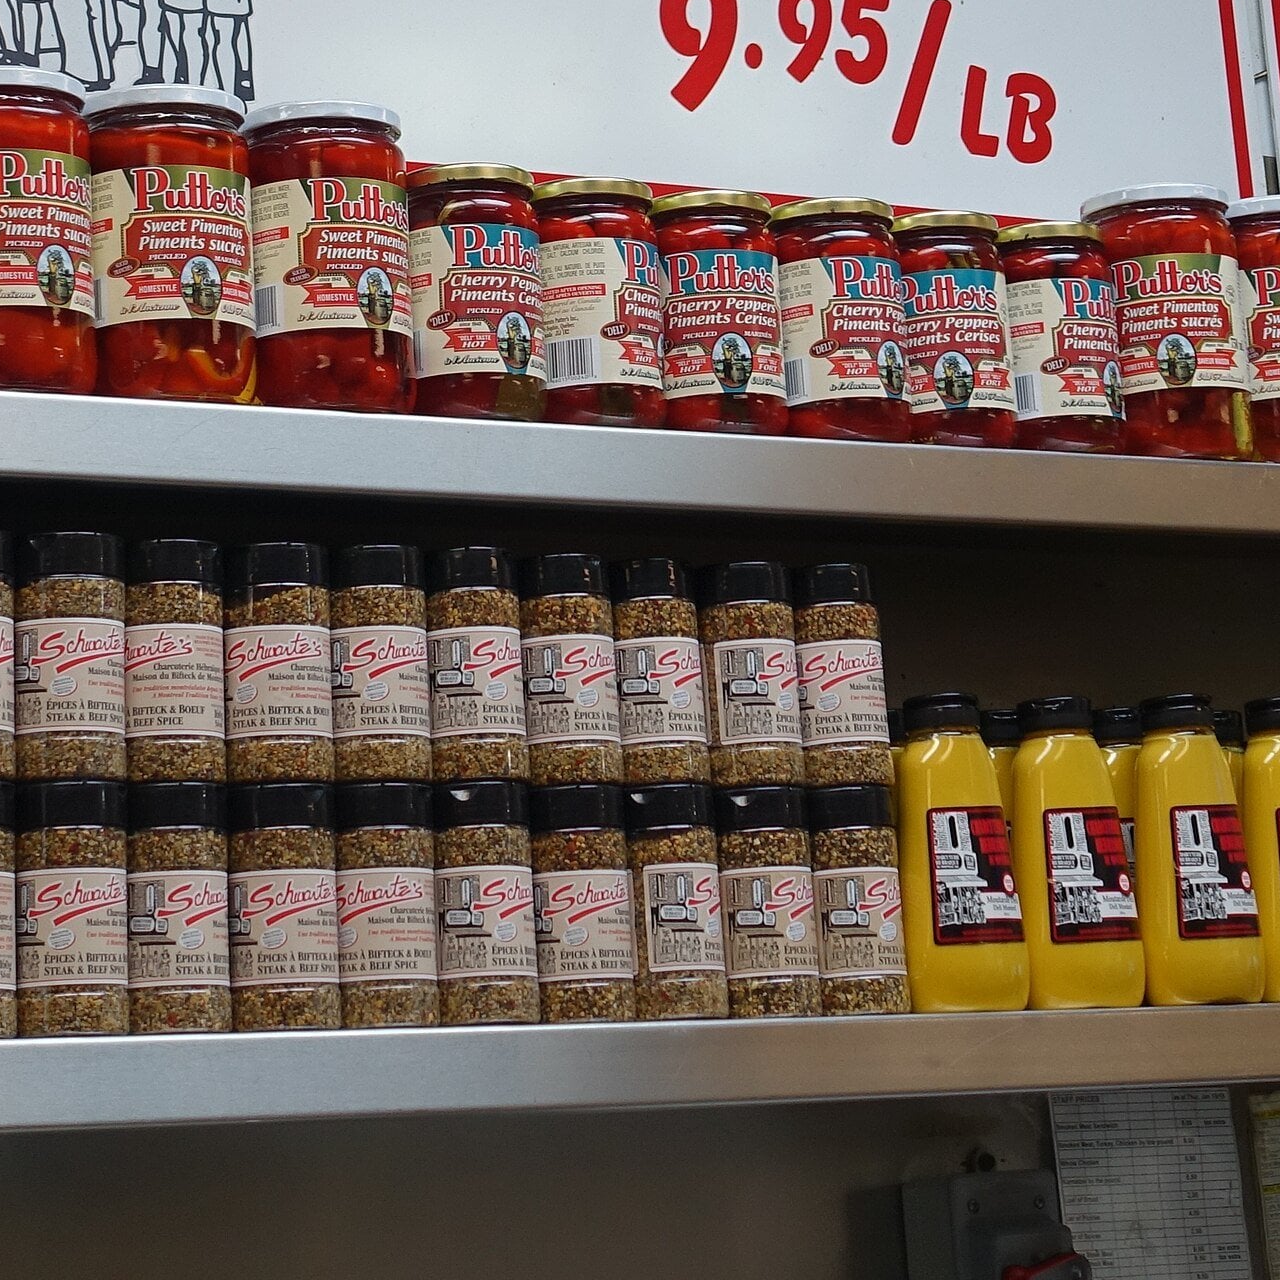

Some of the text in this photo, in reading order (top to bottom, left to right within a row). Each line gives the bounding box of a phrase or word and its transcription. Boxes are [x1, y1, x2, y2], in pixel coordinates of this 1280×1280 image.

[132, 168, 246, 217] Putter's
[142, 219, 243, 240] Sweet Pimentos
[138, 235, 246, 257] Piments sucrés
[450, 274, 515, 289] Cherry
[666, 253, 775, 296] Putter's
[1112, 260, 1222, 301] Putter's
[138, 283, 177, 293] HOMESTYLE
[451, 288, 516, 303] Piments
[668, 298, 776, 315] Cherry Peppers
[1122, 301, 1219, 318] Sweet Pimentos
[668, 312, 777, 329] Piments Cerises
[1121, 314, 1222, 335] Piments sucrés
[233, 715, 317, 729] STEAK BEEF SPICE
